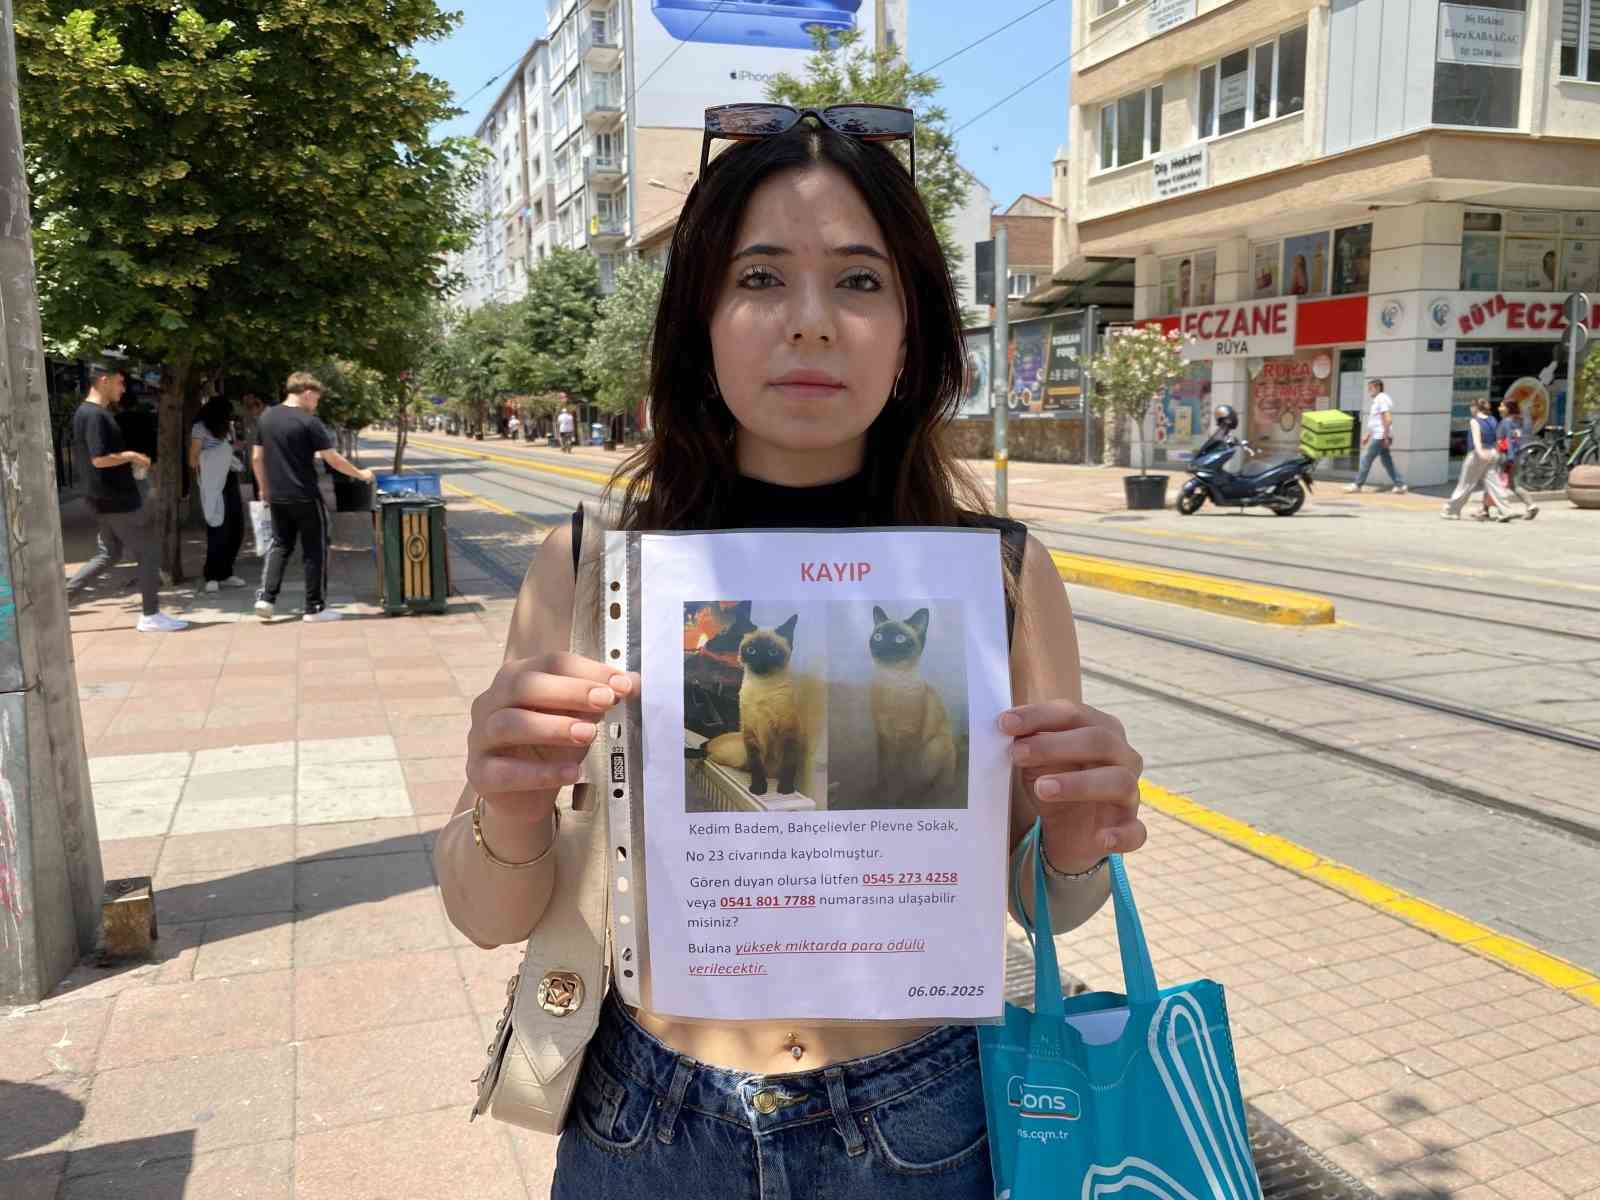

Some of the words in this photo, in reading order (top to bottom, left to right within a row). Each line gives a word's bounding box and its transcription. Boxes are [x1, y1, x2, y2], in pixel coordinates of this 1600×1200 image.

[1185, 303, 1288, 341] ECZANE
[1458, 293, 1507, 335] RÜYA
[1506, 302, 1600, 331] ECZ
[1216, 340, 1249, 356] RÜYA
[801, 562, 871, 582] KAYIP
[689, 824, 730, 834] Kedim
[735, 823, 783, 835] Badem,
[788, 821, 866, 834] Bahçelievler
[870, 821, 912, 831] Plevne
[918, 820, 959, 832] Sokak,
[687, 851, 704, 862] No
[709, 851, 724, 861] 23
[728, 848, 787, 860] civarında
[791, 848, 884, 861] kaybolmuştur.
[690, 877, 730, 888] Gören
[734, 876, 773, 889] duyan
[778, 874, 816, 886] olursa
[821, 874, 858, 885] lütfen
[863, 873, 894, 885] 0545
[898, 873, 921, 884] 273
[926, 872, 958, 884] 4258
[687, 898, 716, 909] veya
[720, 896, 752, 908] 0541
[756, 896, 780, 907] 801
[784, 895, 816, 907] 7788
[820, 894, 894, 905] numarasına
[688, 917, 739, 928] misiniz?
[689, 943, 731, 954] Bulana
[736, 941, 780, 955] yüksek
[786, 940, 847, 952] miktarda
[851, 942, 882, 953] para
[887, 939, 925, 951] ödülü
[689, 962, 767, 975] verilecektir.
[908, 986, 984, 997] 06.06.2025
[1019, 1089, 1066, 1110] ons
